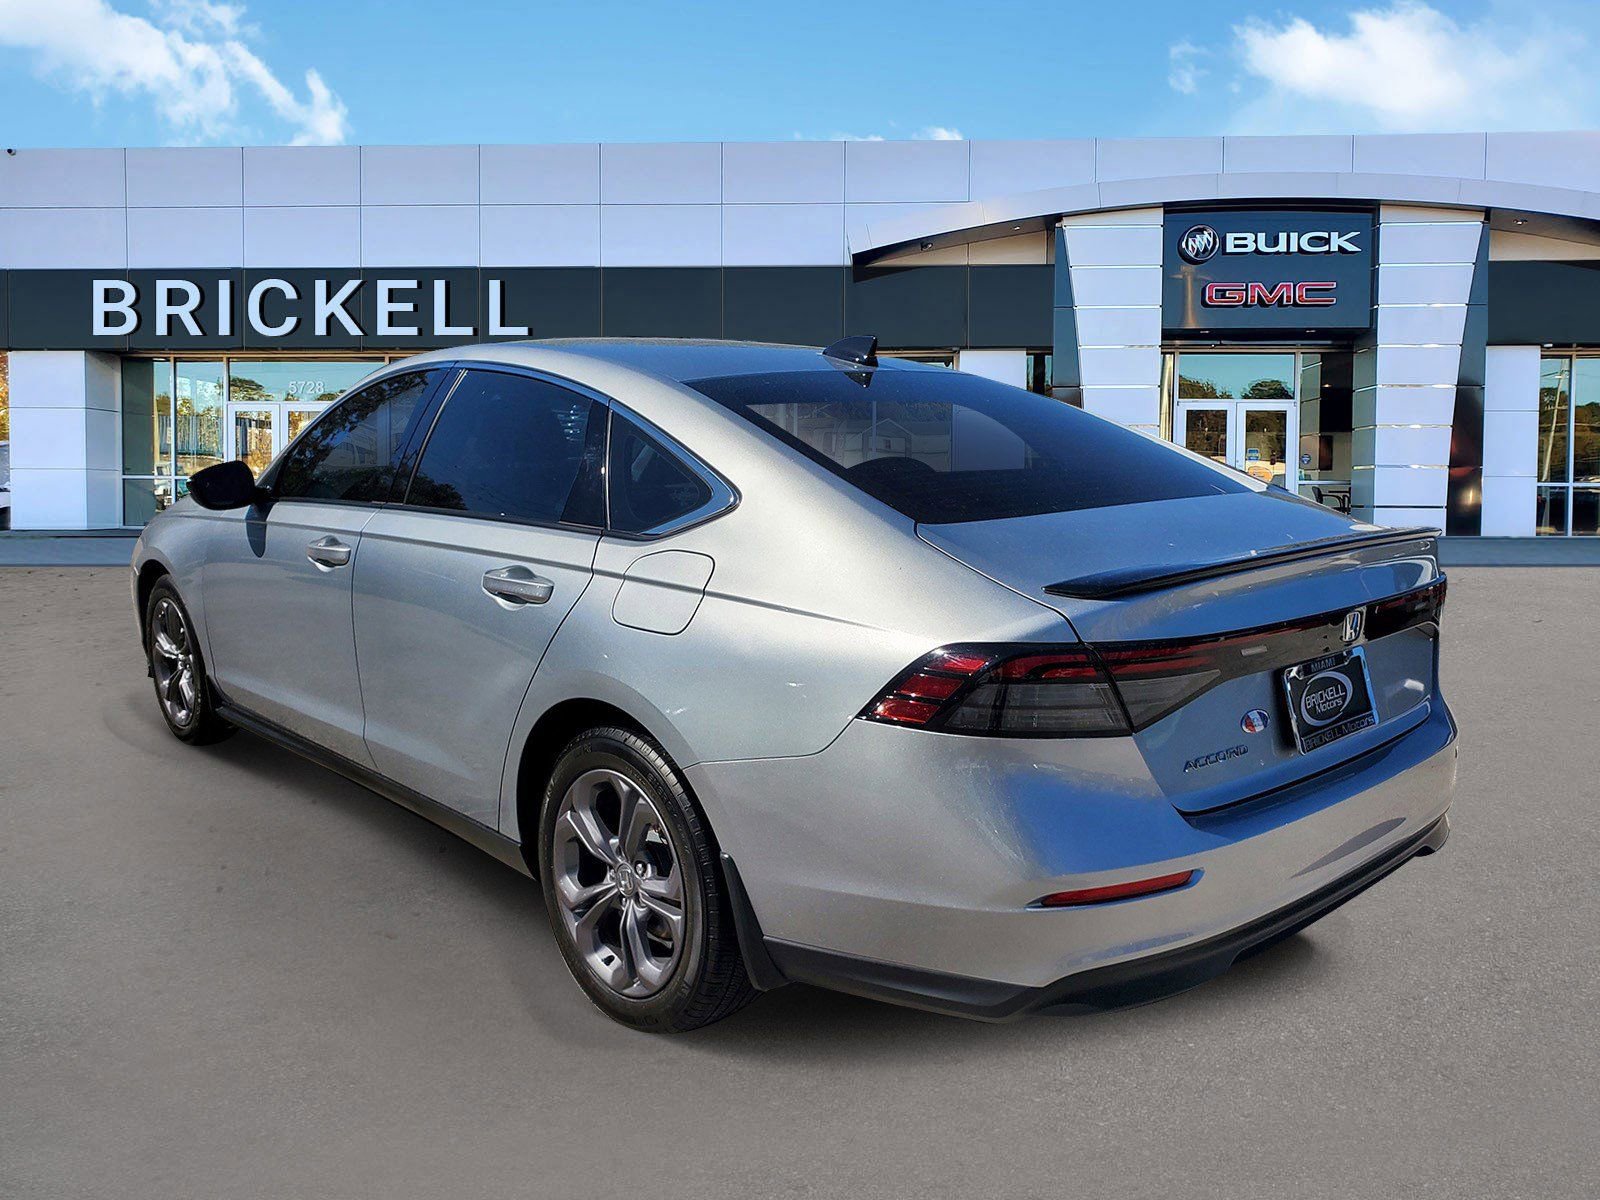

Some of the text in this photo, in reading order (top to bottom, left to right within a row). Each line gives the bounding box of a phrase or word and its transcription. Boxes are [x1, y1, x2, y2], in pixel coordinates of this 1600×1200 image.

[1226, 231, 1362, 253] BUICK
[1206, 282, 1337, 305] GMC
[92, 278, 530, 337] BRICKELL
[289, 381, 325, 394] 5728
[1311, 658, 1336, 673] MIAMI
[1305, 684, 1346, 709] BRICKELL
[1315, 698, 1343, 715] Motors
[1305, 715, 1375, 751] BRICKELL Motors
[1183, 745, 1249, 774] ACCORD
